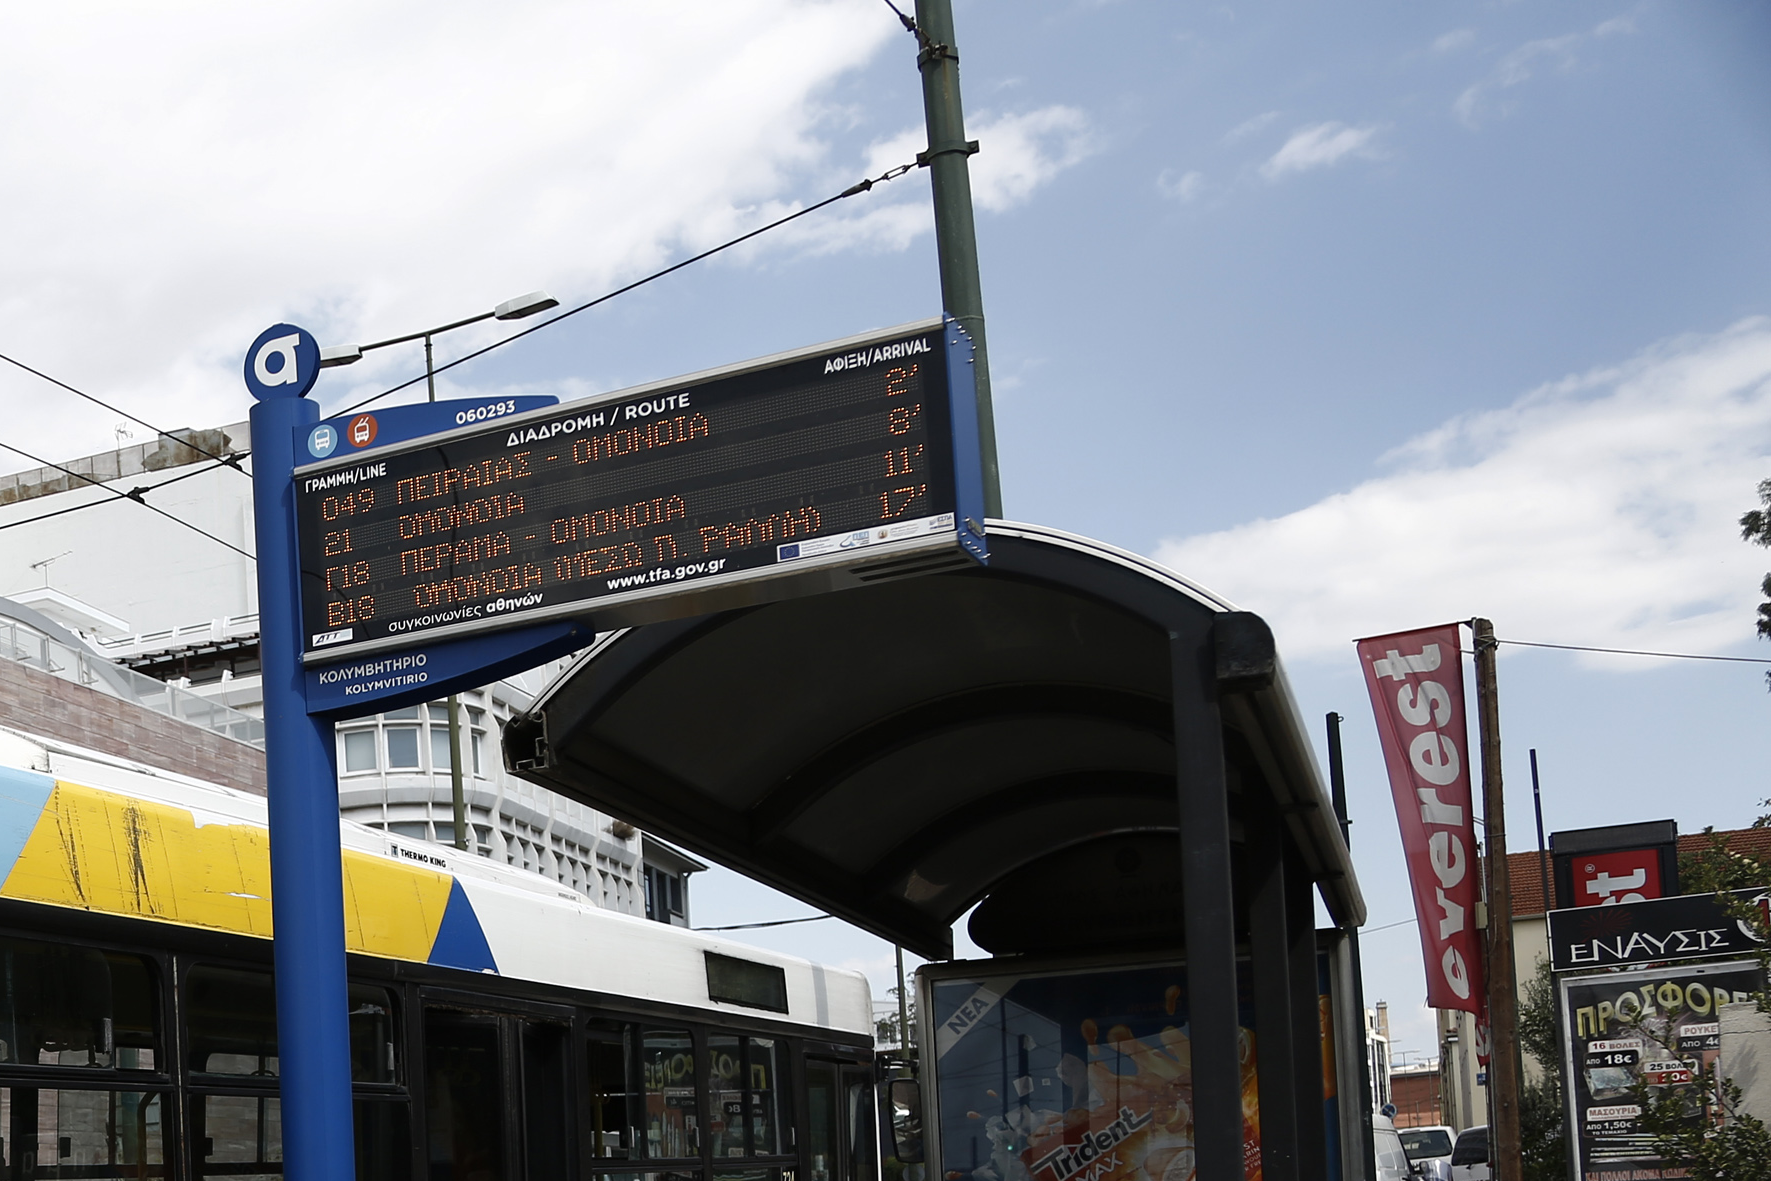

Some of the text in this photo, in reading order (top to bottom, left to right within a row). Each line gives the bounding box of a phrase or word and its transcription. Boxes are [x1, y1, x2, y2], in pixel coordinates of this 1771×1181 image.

[824, 338, 931, 375] ΑΦΙΞΗ/ARRIVAL
[455, 400, 515, 425] 060293
[506, 411, 605, 447] ΔΙΑΔΡΟΜΗ
[625, 392, 691, 420] ROUTE
[397, 451, 532, 504] ΠΕΙΡΑΙΑΣ
[572, 412, 709, 464] ΟΜΟΝΟΙΑ
[304, 462, 387, 493] ΓΡΑΜΜΗ/LINE
[322, 488, 375, 521] 049
[398, 492, 525, 540] ΟΜΟΝΟΙΑ
[324, 527, 354, 556] 21
[401, 531, 510, 576] ΠΕΡΑΜΑ
[551, 494, 685, 544] ΟΜΟΝΟΙΑ
[326, 560, 370, 591] Γ18
[412, 562, 542, 609] ΟΜΟΝΟΙΑ
[607, 557, 727, 590] www.tfa.gov.gr
[388, 592, 544, 632] συγκοινωνίες αθηνών
[319, 653, 427, 684] ΚΟΛΥΜΒΗΤΗΡΙΟ
[345, 672, 428, 695] KOLYMVITIRIO
[1373, 643, 1471, 999] everest
[400, 848, 446, 868] THERMO KING
[1570, 928, 1729, 962] ΕΝΑΥΣΙΣ
[1576, 981, 1764, 1040] ΠΡΟΣΦΟΡ
[1684, 1025, 1718, 1034] ΡΟΥΚΕ
[1604, 1053, 1632, 1064] 18€
